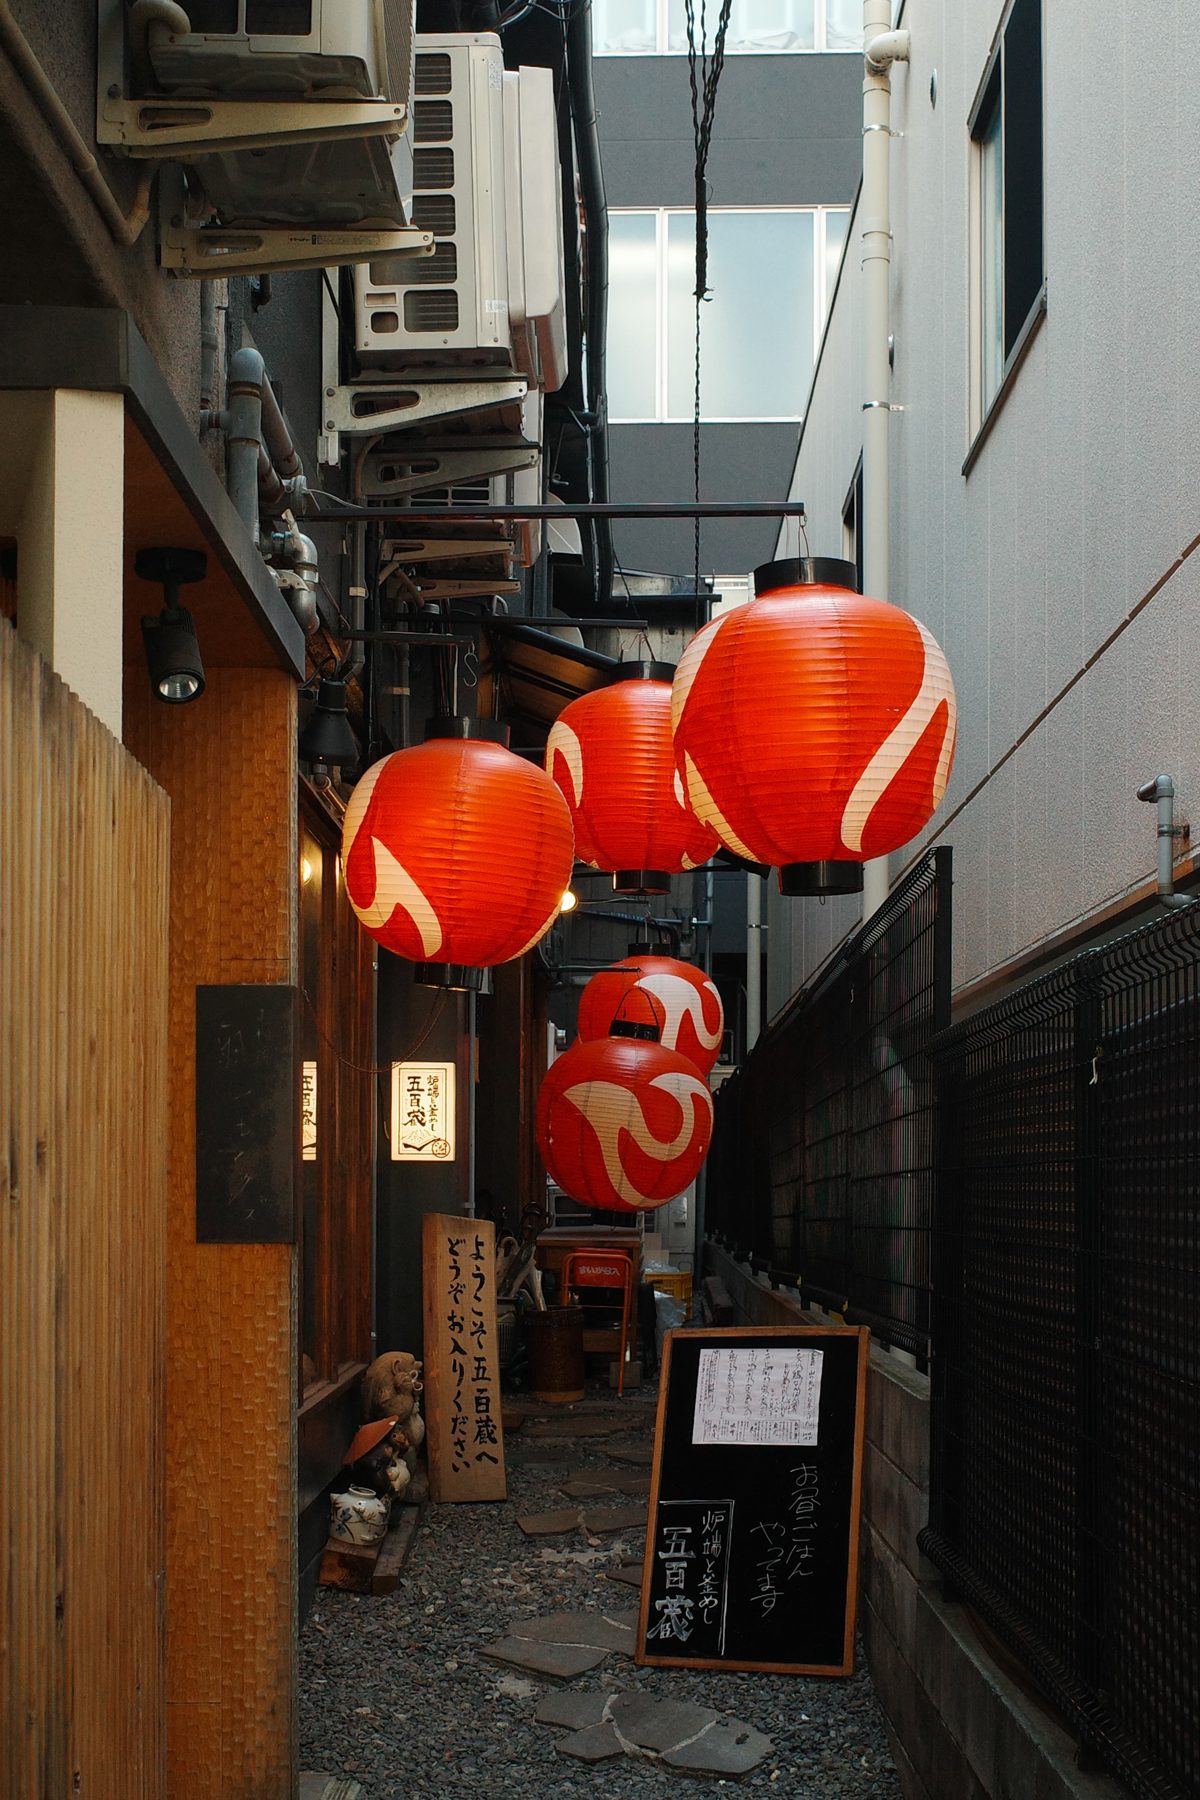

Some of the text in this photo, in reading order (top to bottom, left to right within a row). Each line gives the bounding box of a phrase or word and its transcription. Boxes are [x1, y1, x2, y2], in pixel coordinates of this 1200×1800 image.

[402, 1076, 427, 1127] 五百蔵
[446, 1236, 471, 1473] どうぞお入りください
[469, 1234, 499, 1465] ようこそ五百蔵へ
[698, 1510, 727, 1625] 炉端と釜めし
[749, 1521, 786, 1618] やってます
[786, 1462, 822, 1581] お昼ごはん
[646, 1526, 696, 1642] 五百蔵
